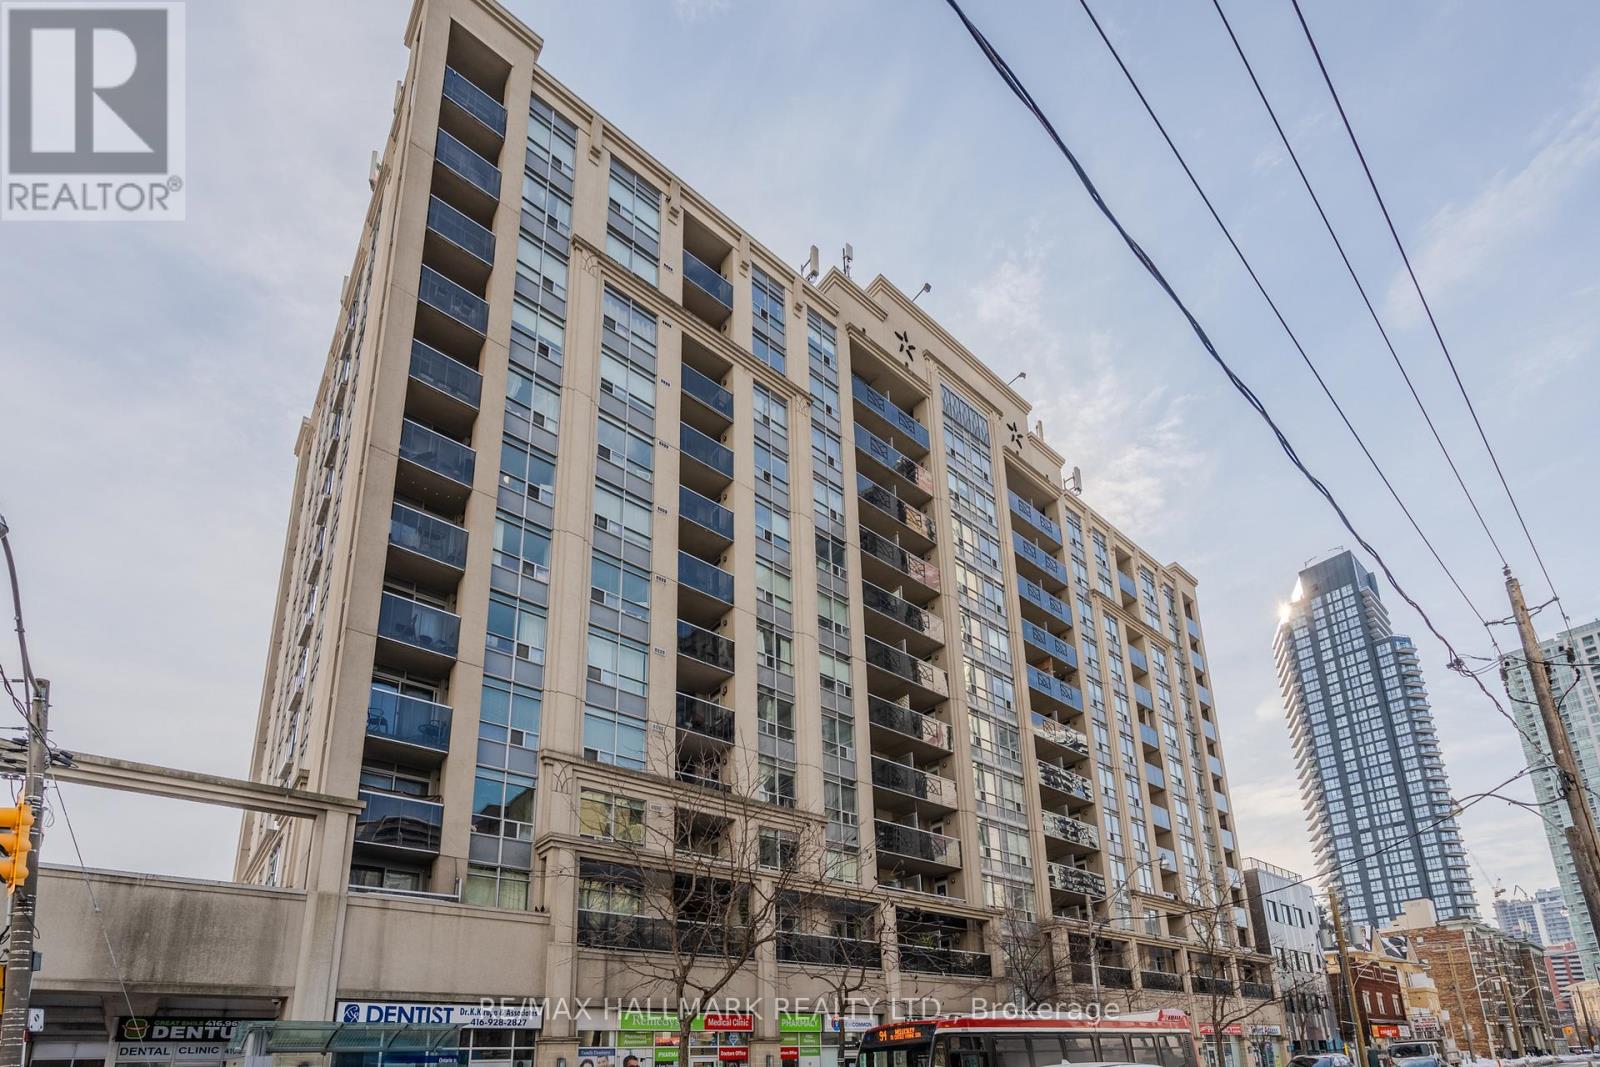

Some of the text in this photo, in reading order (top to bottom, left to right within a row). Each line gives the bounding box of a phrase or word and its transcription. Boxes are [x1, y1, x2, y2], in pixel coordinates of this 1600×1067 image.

[366, 1005, 454, 1024] DENTIST
[205, 1020, 240, 1028] 416.96
[470, 1018, 527, 1027] 416-928-2827
[708, 1018, 750, 1027] Medical Clinic
[119, 1047, 170, 1056] DENTAL
[178, 1046, 219, 1055] CLINIC
